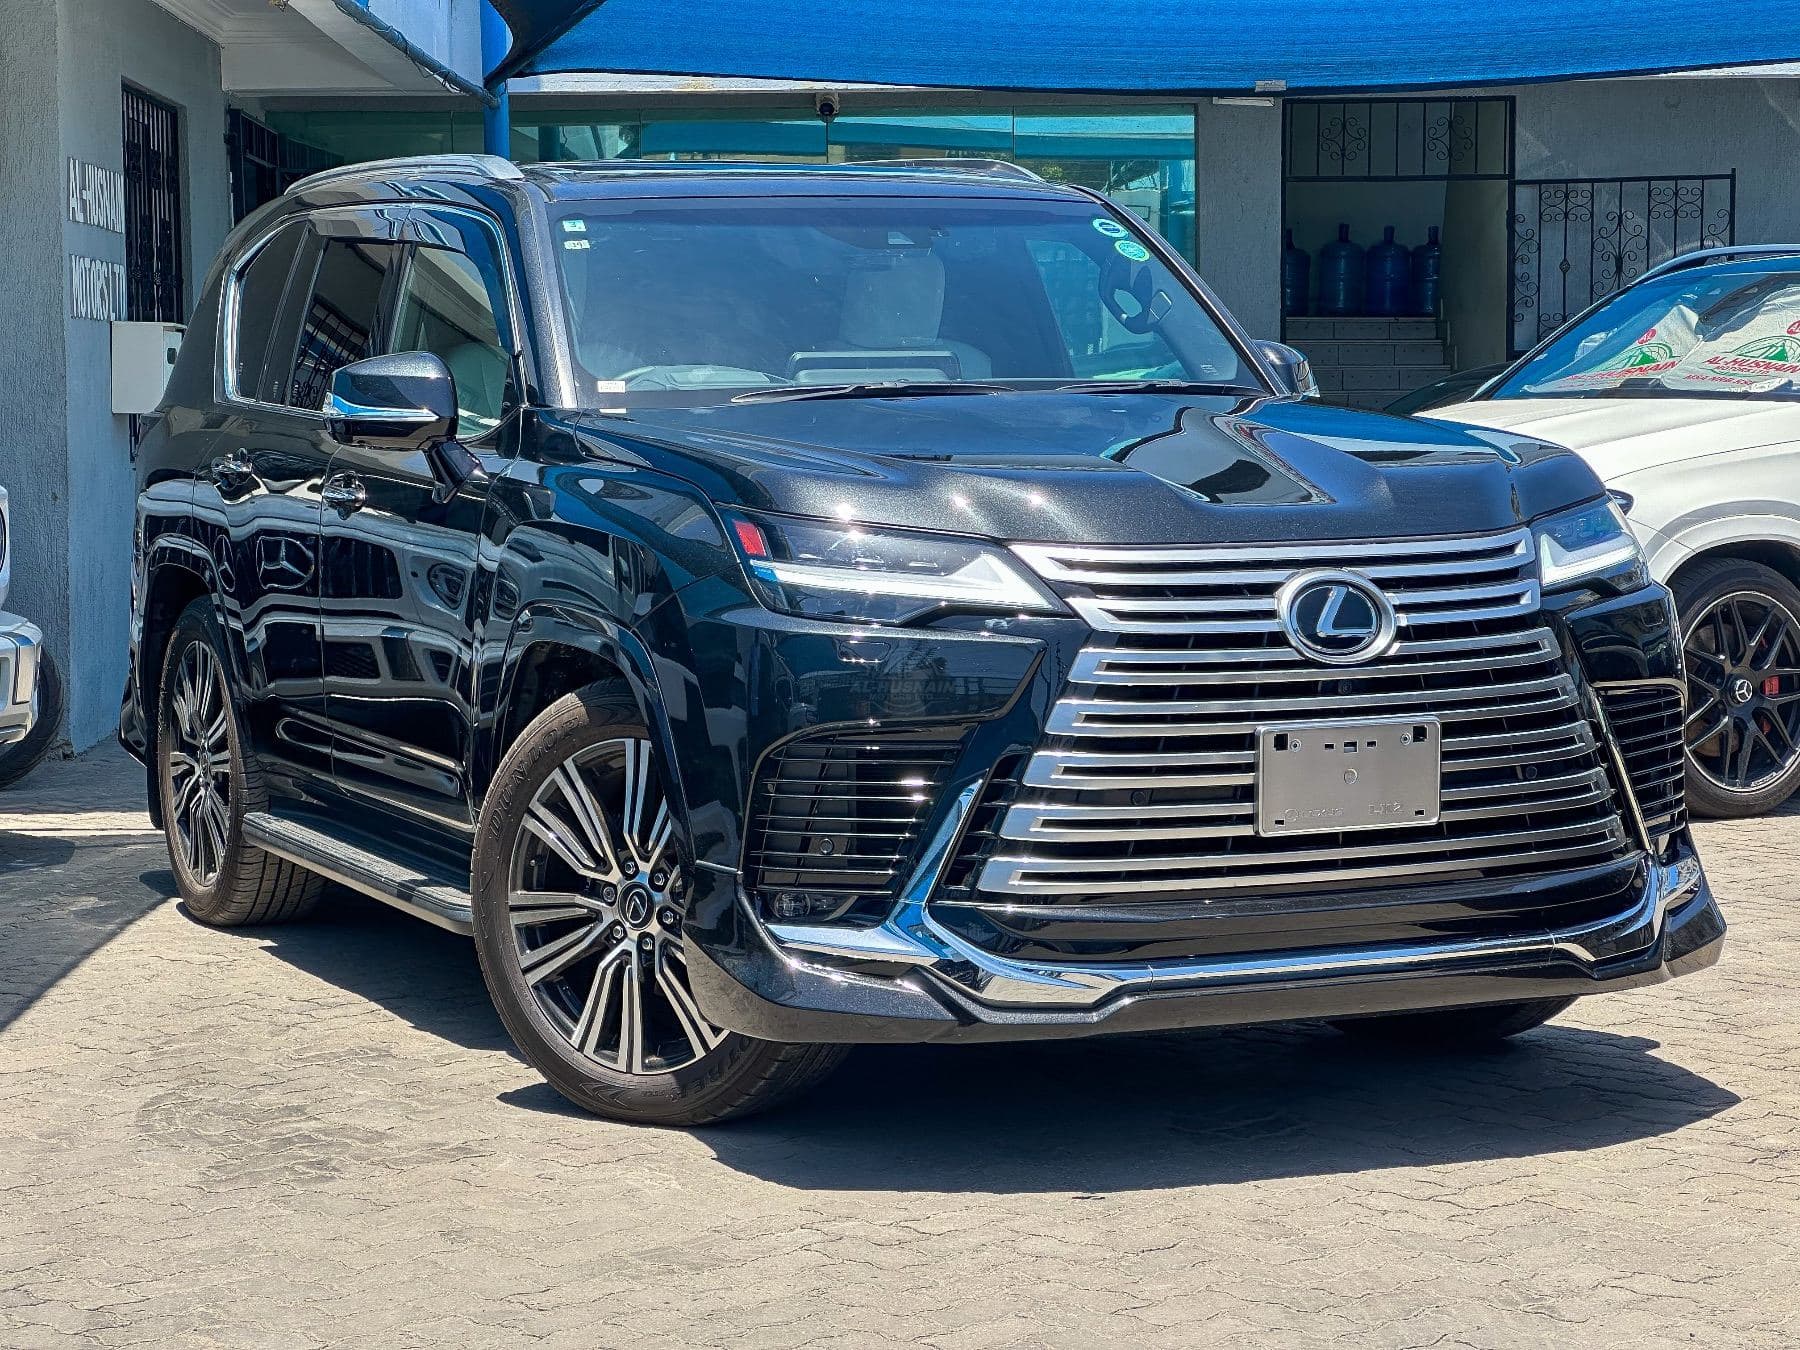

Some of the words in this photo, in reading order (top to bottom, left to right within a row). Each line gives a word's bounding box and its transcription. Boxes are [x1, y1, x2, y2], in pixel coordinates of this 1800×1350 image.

[68, 156, 125, 234] AL-HUSNAIN
[71, 254, 108, 321] MOTORS
[109, 262, 128, 322] LTD
